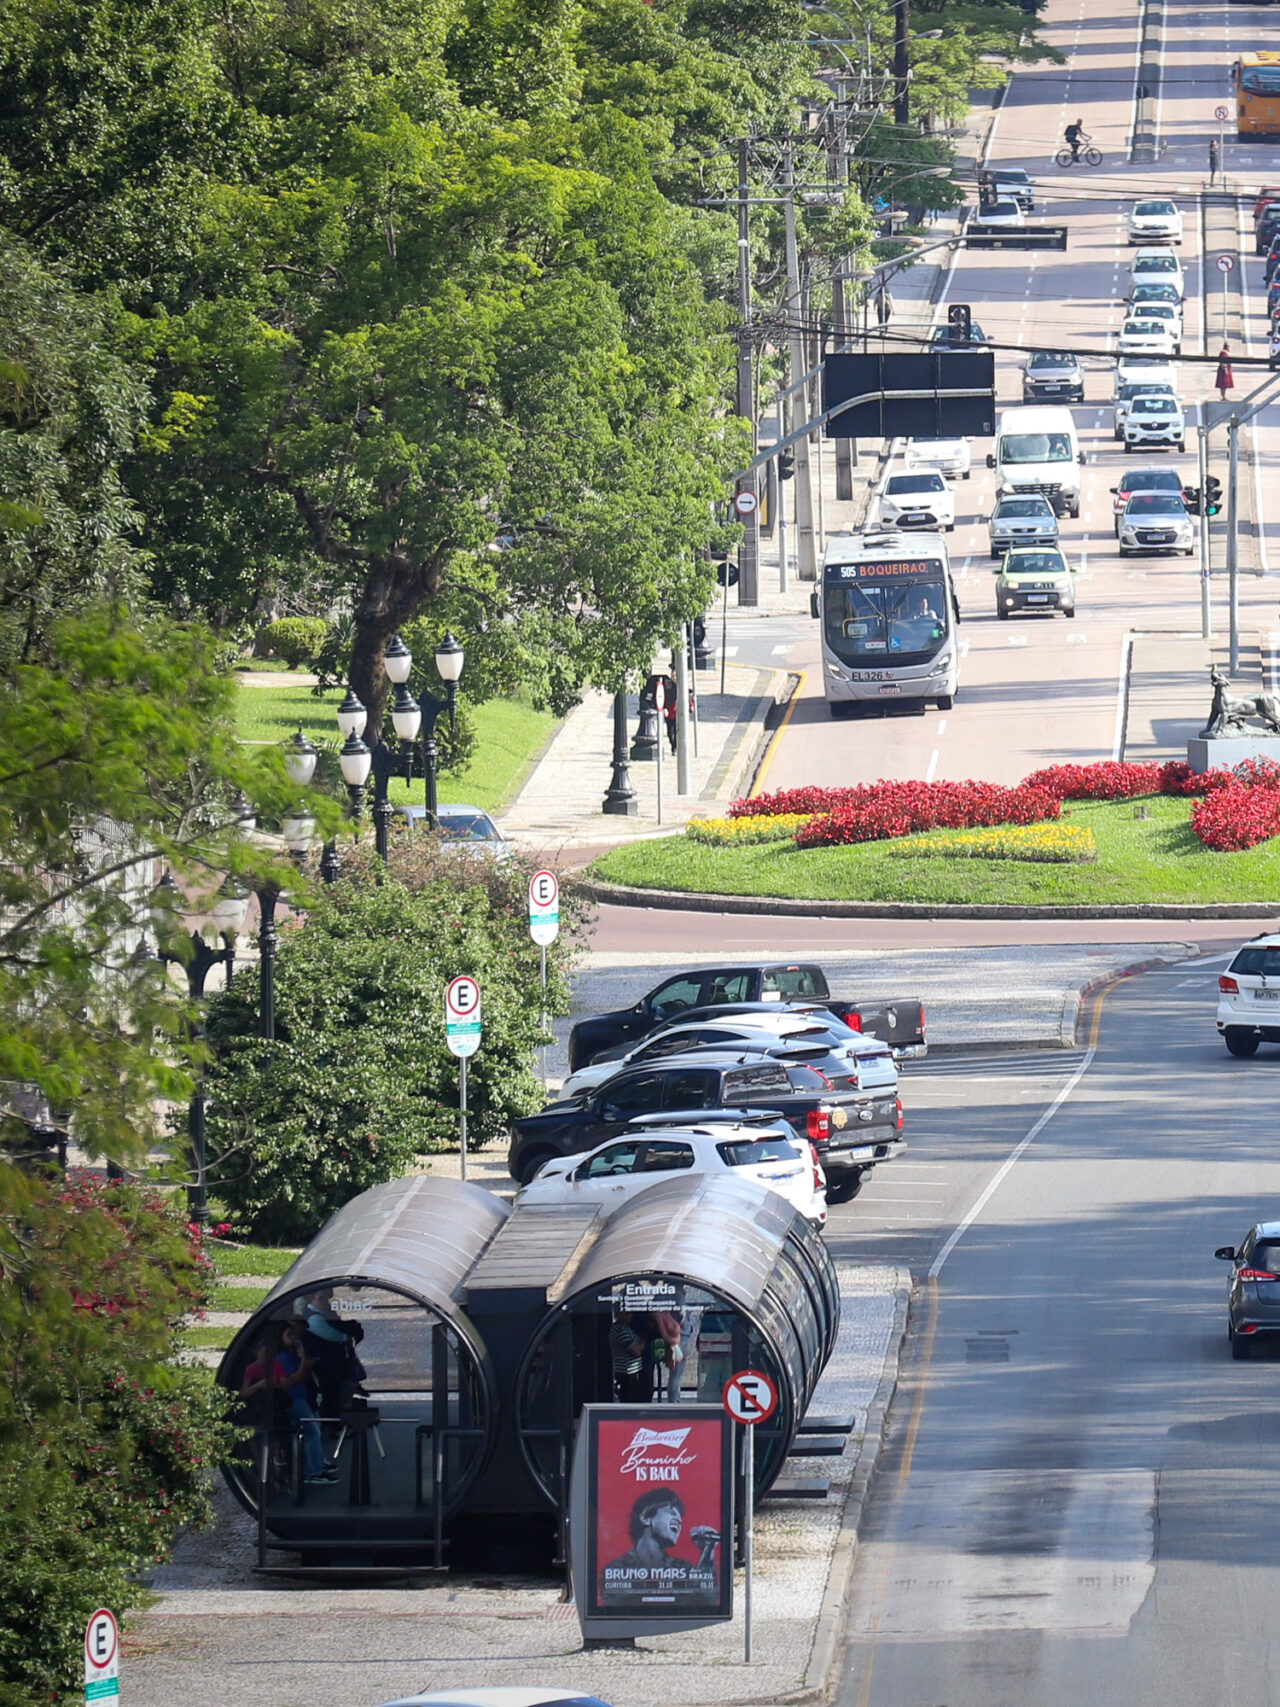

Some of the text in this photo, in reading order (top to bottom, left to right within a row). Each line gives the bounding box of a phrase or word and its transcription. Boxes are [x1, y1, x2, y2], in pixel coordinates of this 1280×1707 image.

[840, 566, 856, 578] 505
[852, 672, 883, 680] EL326
[540, 879, 548, 898] E
[459, 985, 468, 1006] E
[626, 1284, 676, 1295] Entrada
[620, 1445, 698, 1474] Bruninho
[636, 1466, 679, 1481] IS BACK
[605, 1568, 648, 1579] BRUNO
[651, 1568, 686, 1579] MARS
[96, 1622, 106, 1655] E
